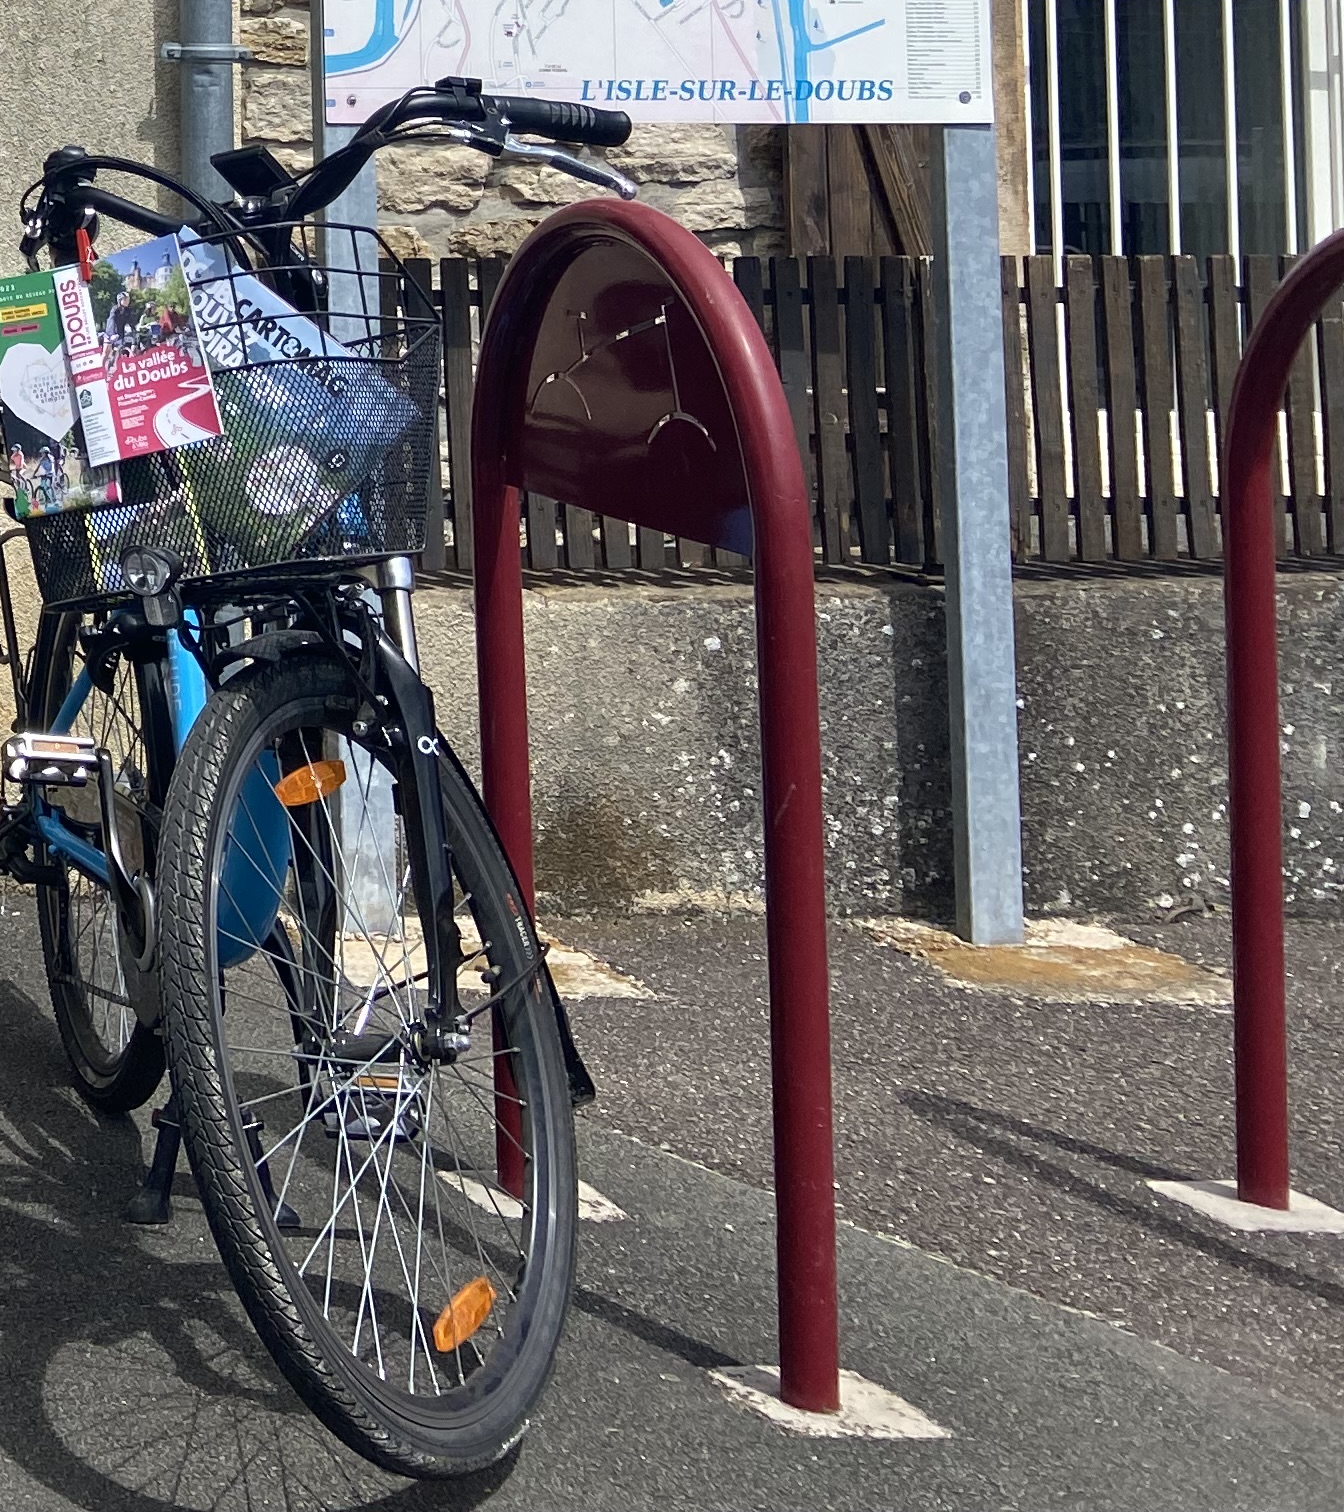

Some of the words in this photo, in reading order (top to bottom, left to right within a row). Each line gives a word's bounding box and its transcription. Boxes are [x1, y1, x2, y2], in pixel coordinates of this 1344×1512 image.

[580, 79, 893, 102] L'ISLE-SUR-LE-DOUBS
[121, 361, 136, 373] La
[137, 350, 175, 369] vallée
[113, 374, 135, 391] du
[137, 361, 188, 385] Doubs
